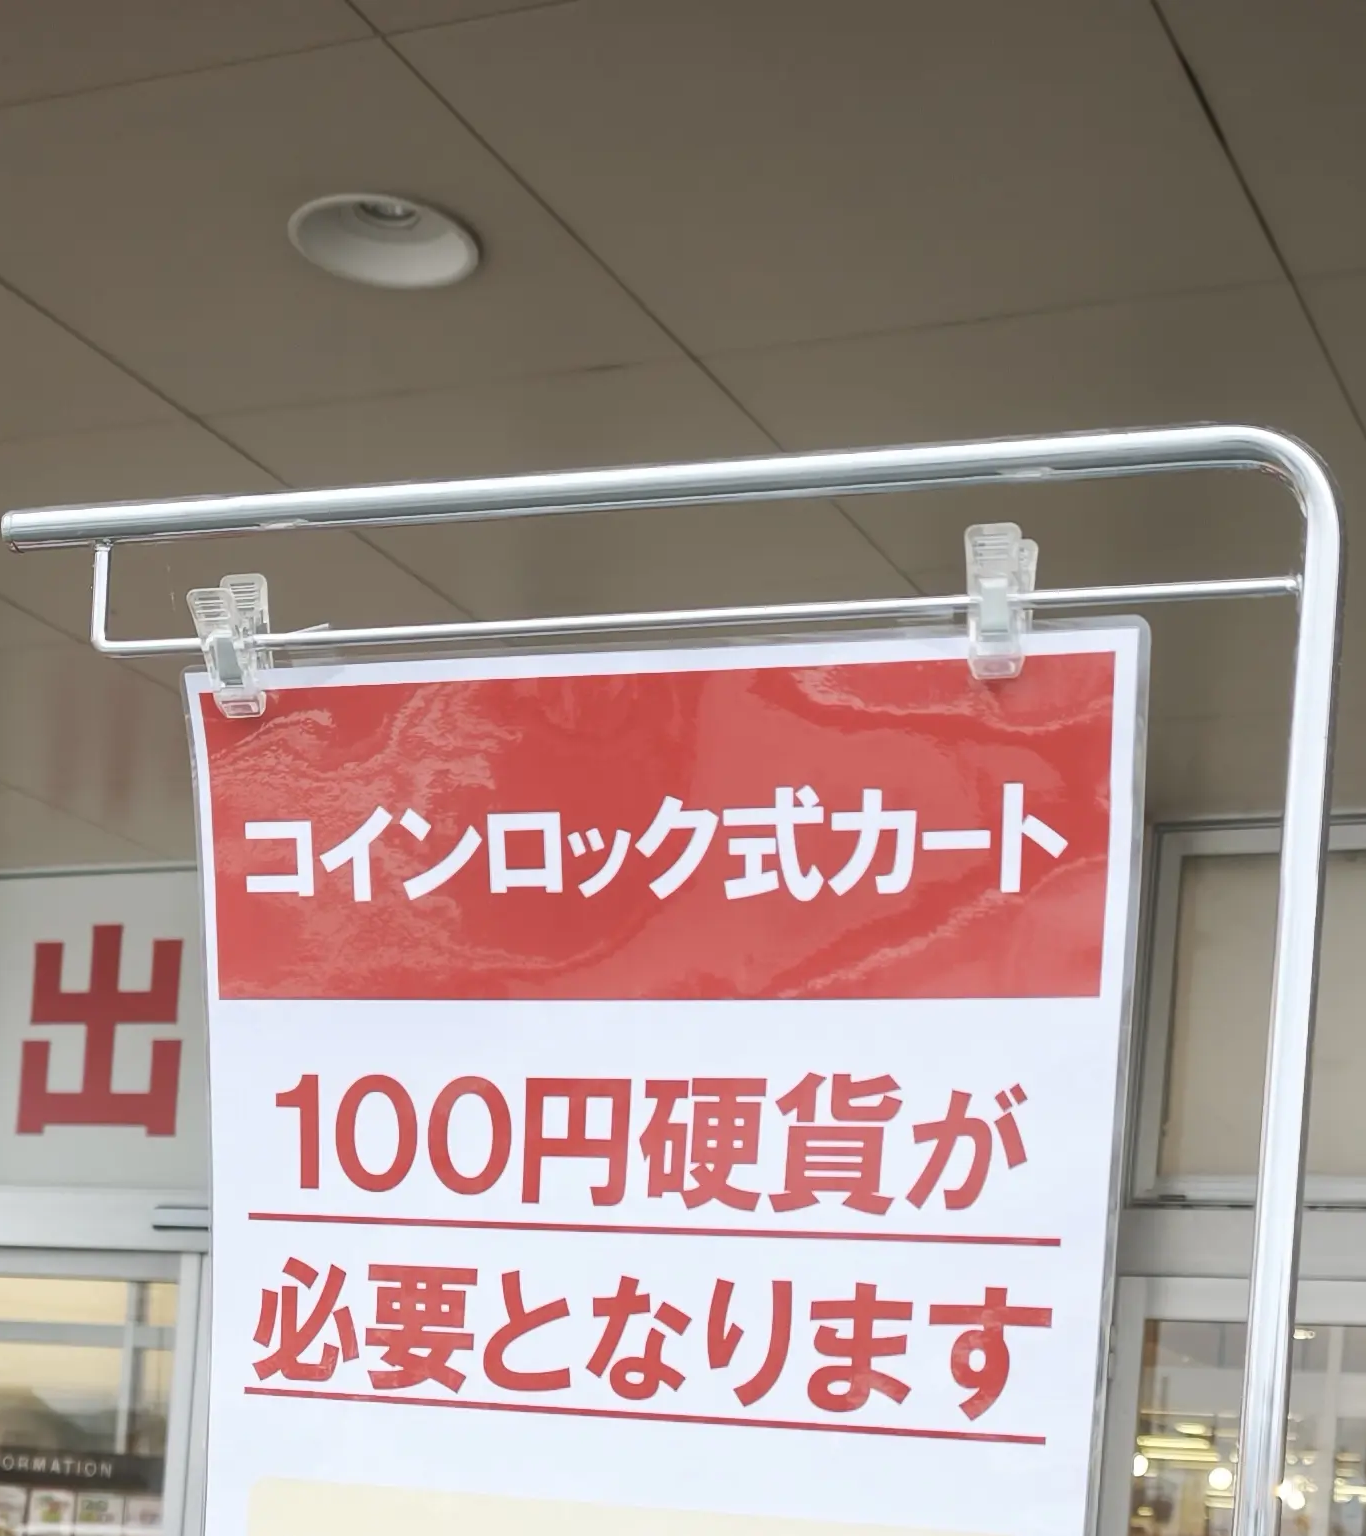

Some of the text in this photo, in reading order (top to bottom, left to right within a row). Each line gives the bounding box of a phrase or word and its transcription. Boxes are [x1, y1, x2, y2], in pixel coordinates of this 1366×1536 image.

[244, 783, 1069, 902] コインロック式カート
[15, 923, 184, 1137] 出
[275, 1072, 1028, 1214] 100円硬貨が
[254, 1256, 1052, 1421] 必要となります
